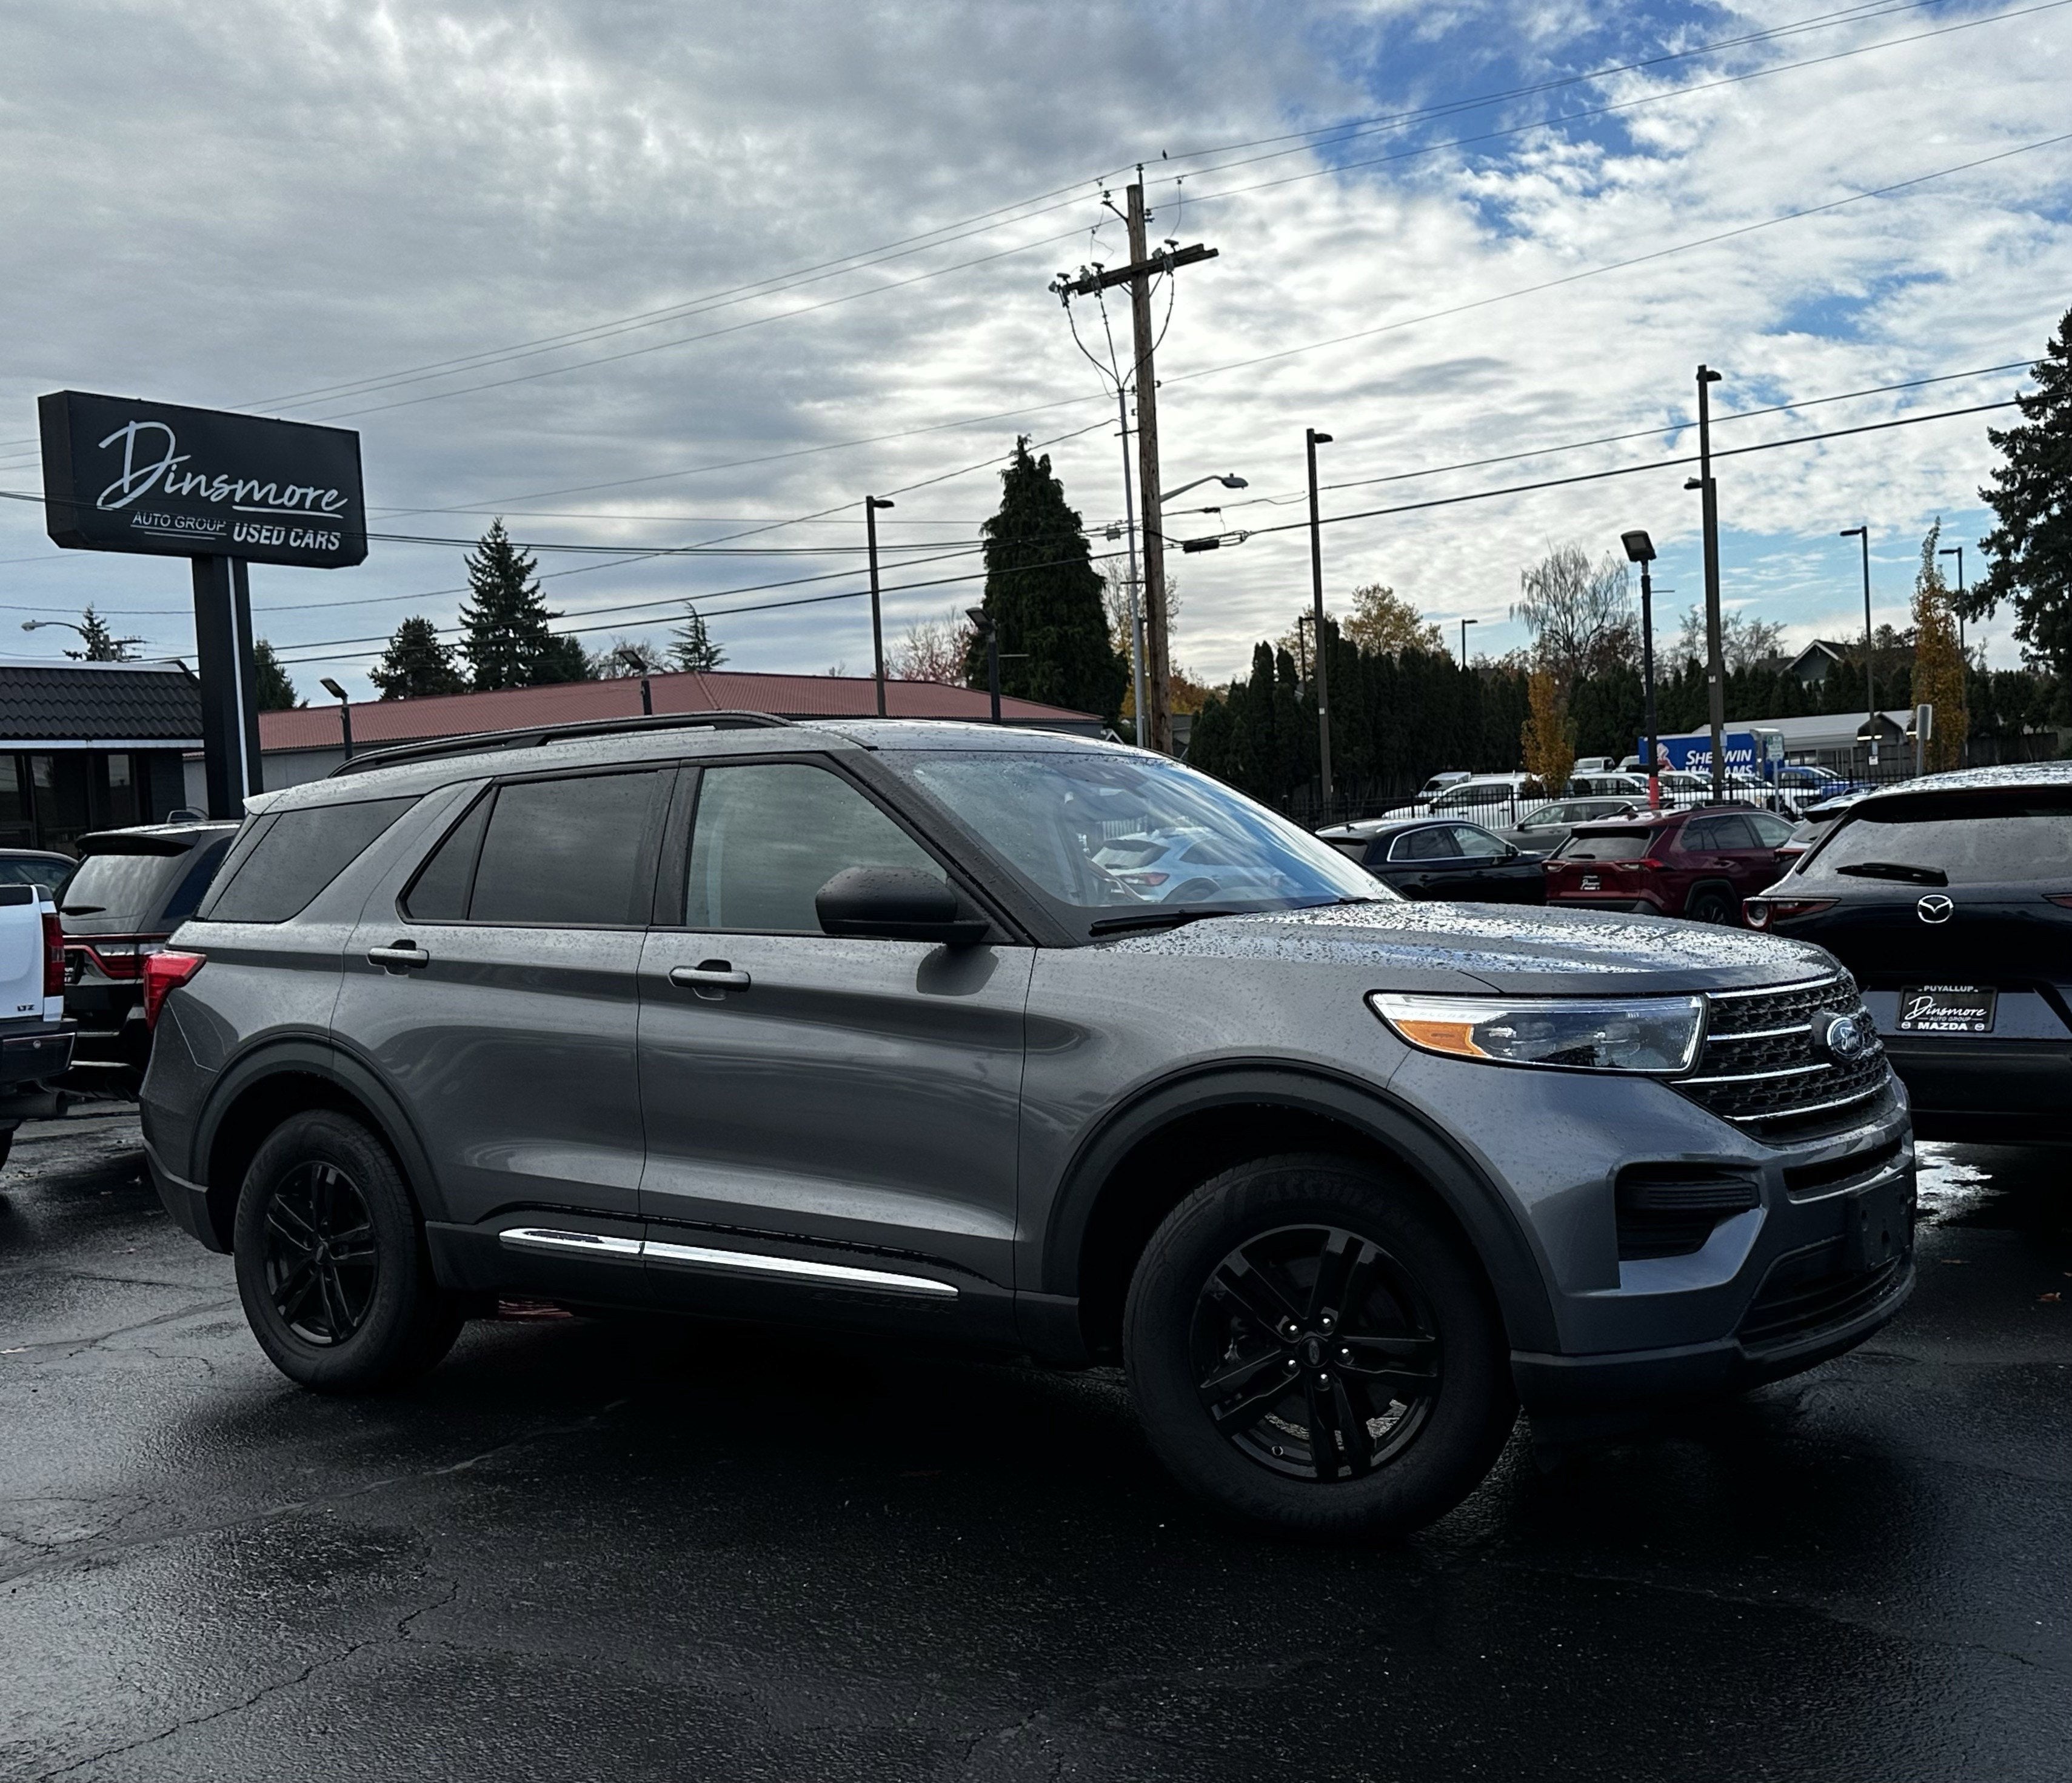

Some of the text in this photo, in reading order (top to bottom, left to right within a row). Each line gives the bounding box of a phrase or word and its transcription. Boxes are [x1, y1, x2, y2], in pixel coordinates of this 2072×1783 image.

[97, 420, 349, 512] Dinsmore
[132, 512, 227, 532] AUTO GROUP
[233, 522, 341, 551] USED CARS
[1685, 749, 1752, 765] SHEWIN
[1905, 996, 1987, 1021] Dinsmore
